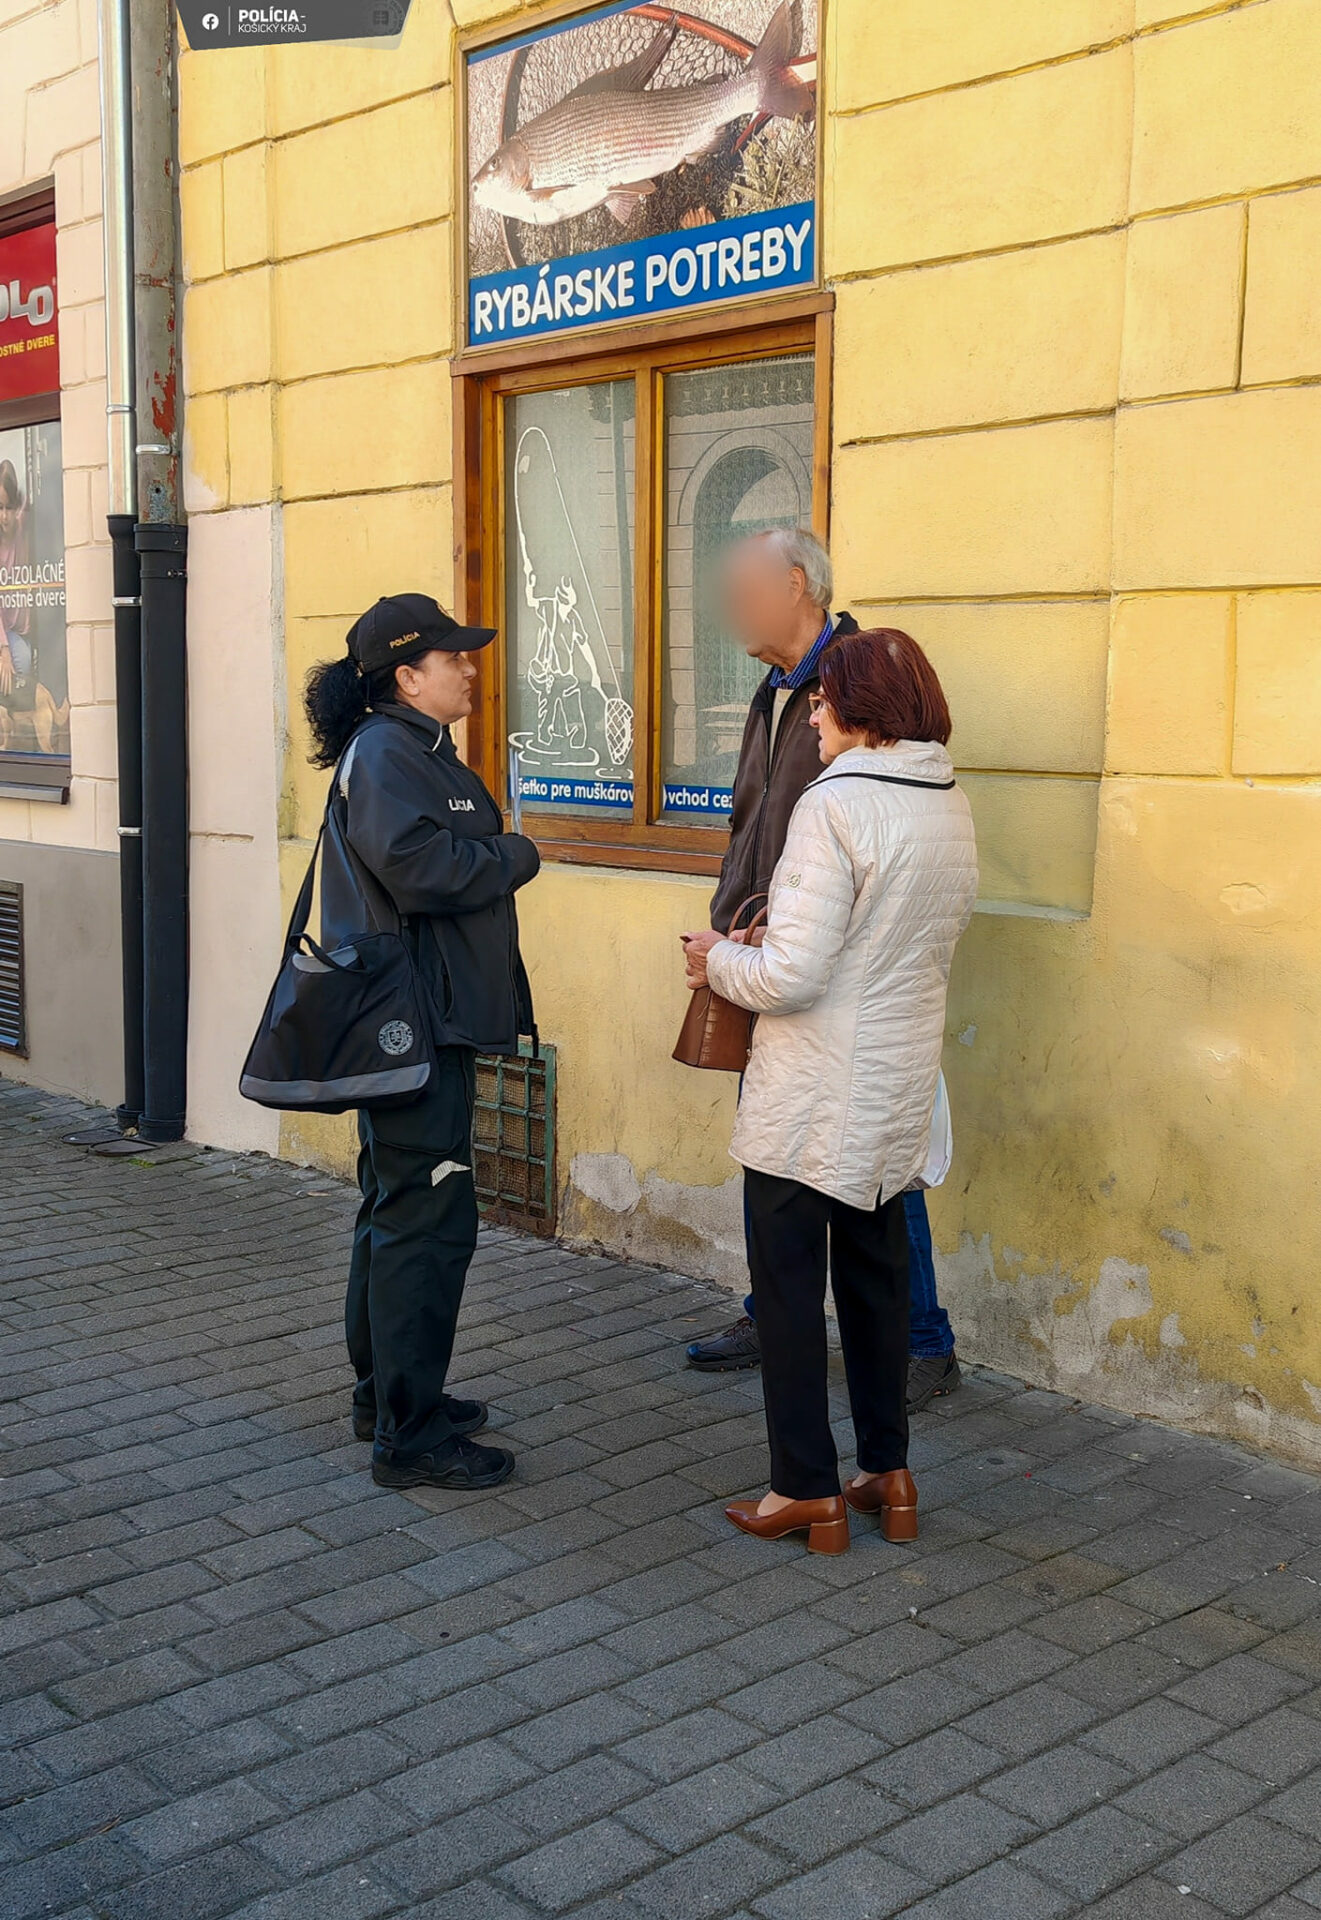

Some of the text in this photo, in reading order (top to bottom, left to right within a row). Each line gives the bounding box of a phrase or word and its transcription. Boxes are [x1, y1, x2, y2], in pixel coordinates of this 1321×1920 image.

[474, 218, 812, 335] RYBÁRSKE POTREBY
[26, 334, 56, 351] DVERE
[35, 587, 66, 607] dvere
[389, 631, 420, 649] POLÍCIA
[551, 783, 572, 801] pre
[574, 782, 634, 802] muškárov
[668, 787, 709, 807] vchod
